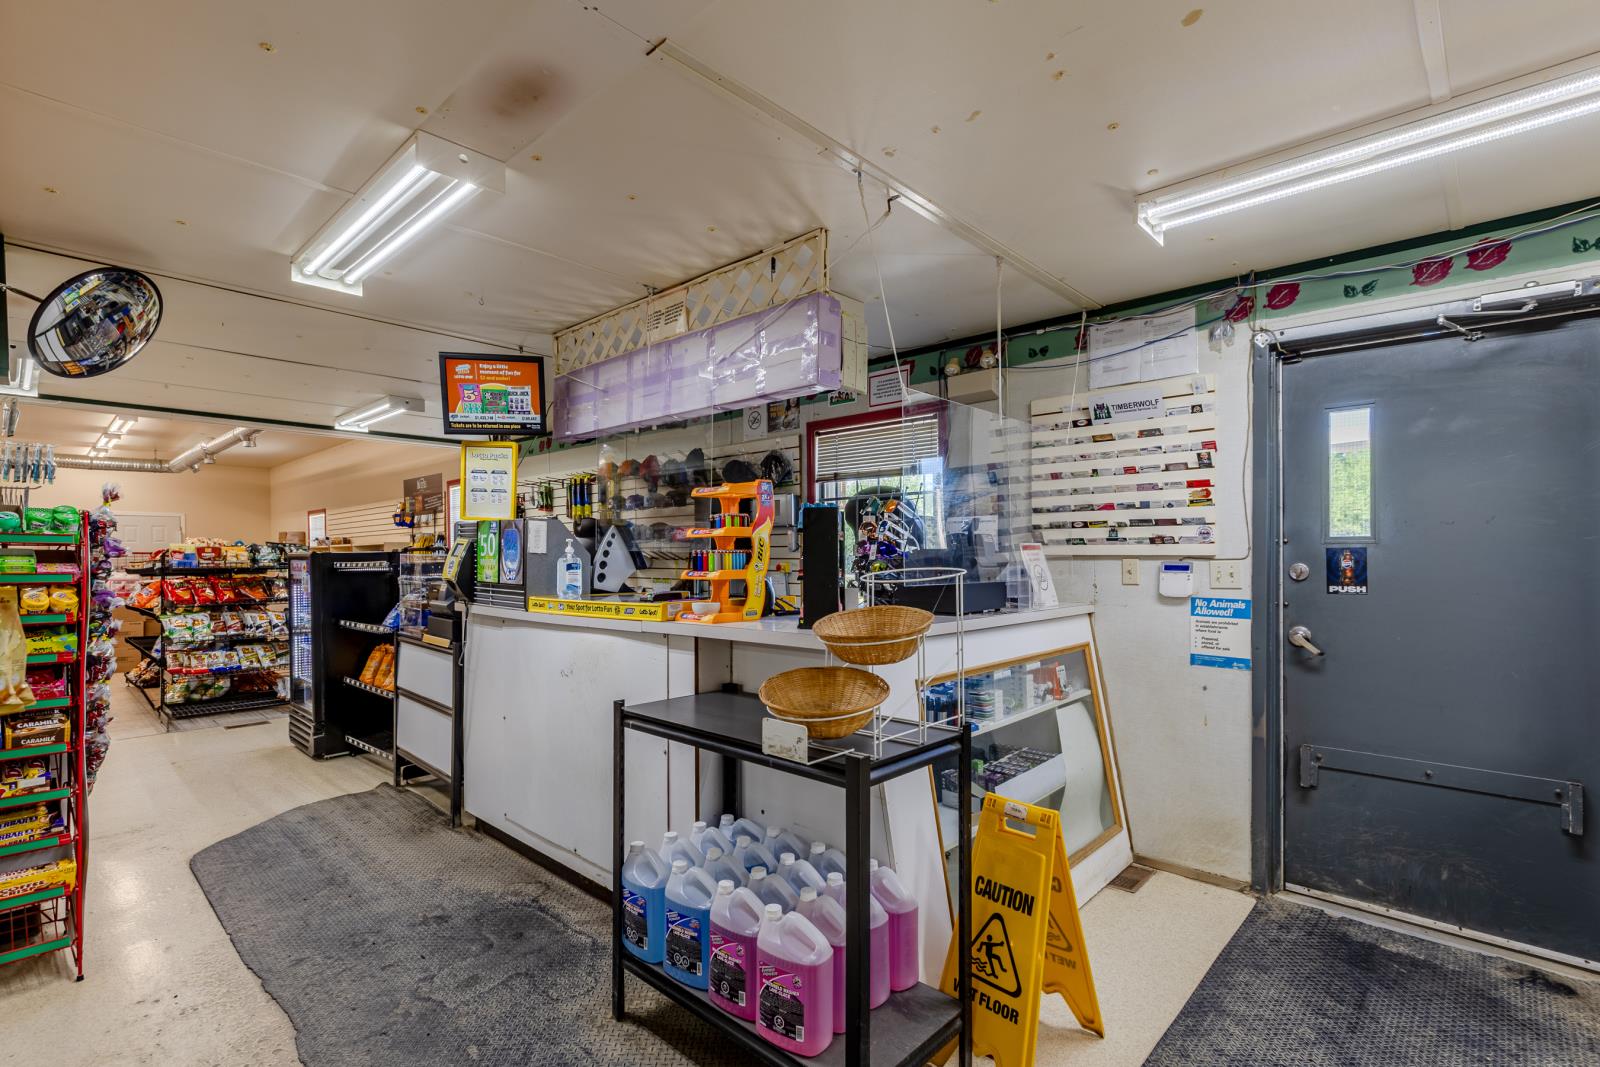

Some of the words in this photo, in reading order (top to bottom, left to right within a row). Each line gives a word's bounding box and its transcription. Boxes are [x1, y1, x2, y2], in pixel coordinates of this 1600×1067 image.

[1111, 399, 1160, 411] TIMBERWOLF
[1210, 600, 1246, 609] Animals
[1194, 607, 1234, 616] Allowed!
[17, 718, 59, 728] CARAMILK
[21, 735, 56, 745] CARAMILK
[975, 876, 1035, 916] CAUTION
[979, 991, 1020, 1024] FLOOR
